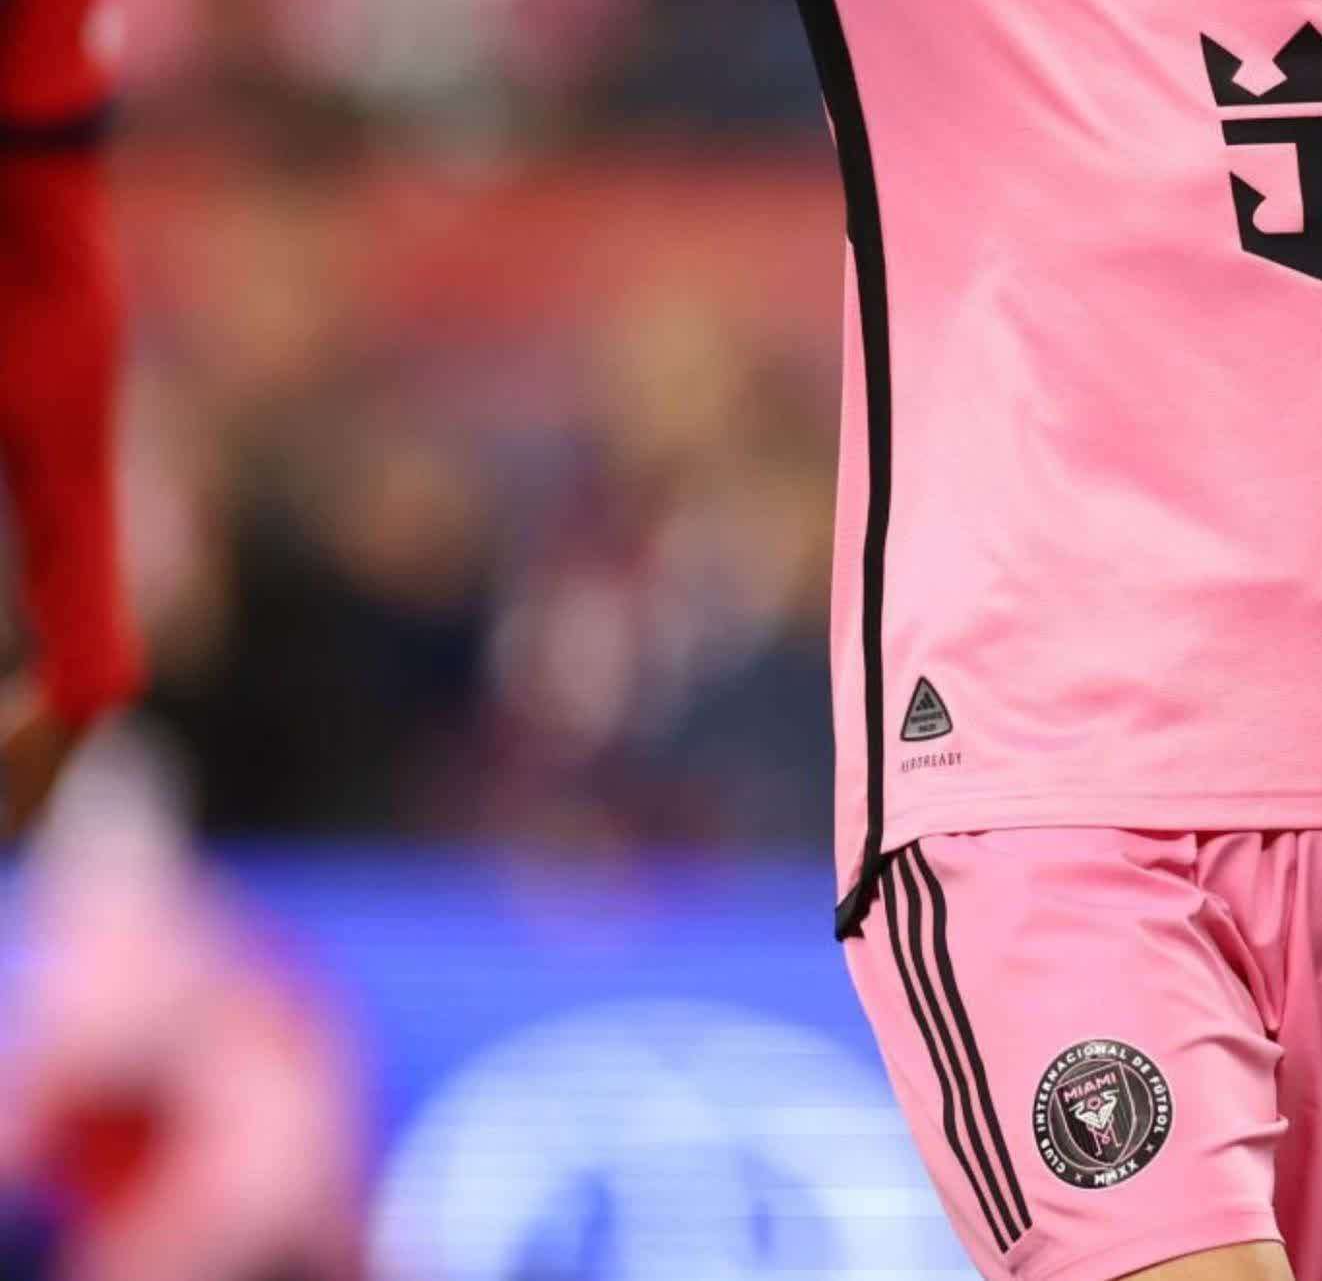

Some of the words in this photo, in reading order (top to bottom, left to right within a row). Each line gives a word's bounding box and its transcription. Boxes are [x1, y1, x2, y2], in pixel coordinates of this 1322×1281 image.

[1132, 1056, 1152, 1073] DE
[1035, 1044, 1127, 1133] INTERNACIONAL
[1063, 1071, 1118, 1103] MIAMI
[1040, 1138, 1067, 1174] CLUB
[1094, 1159, 1140, 1186] MMXX
